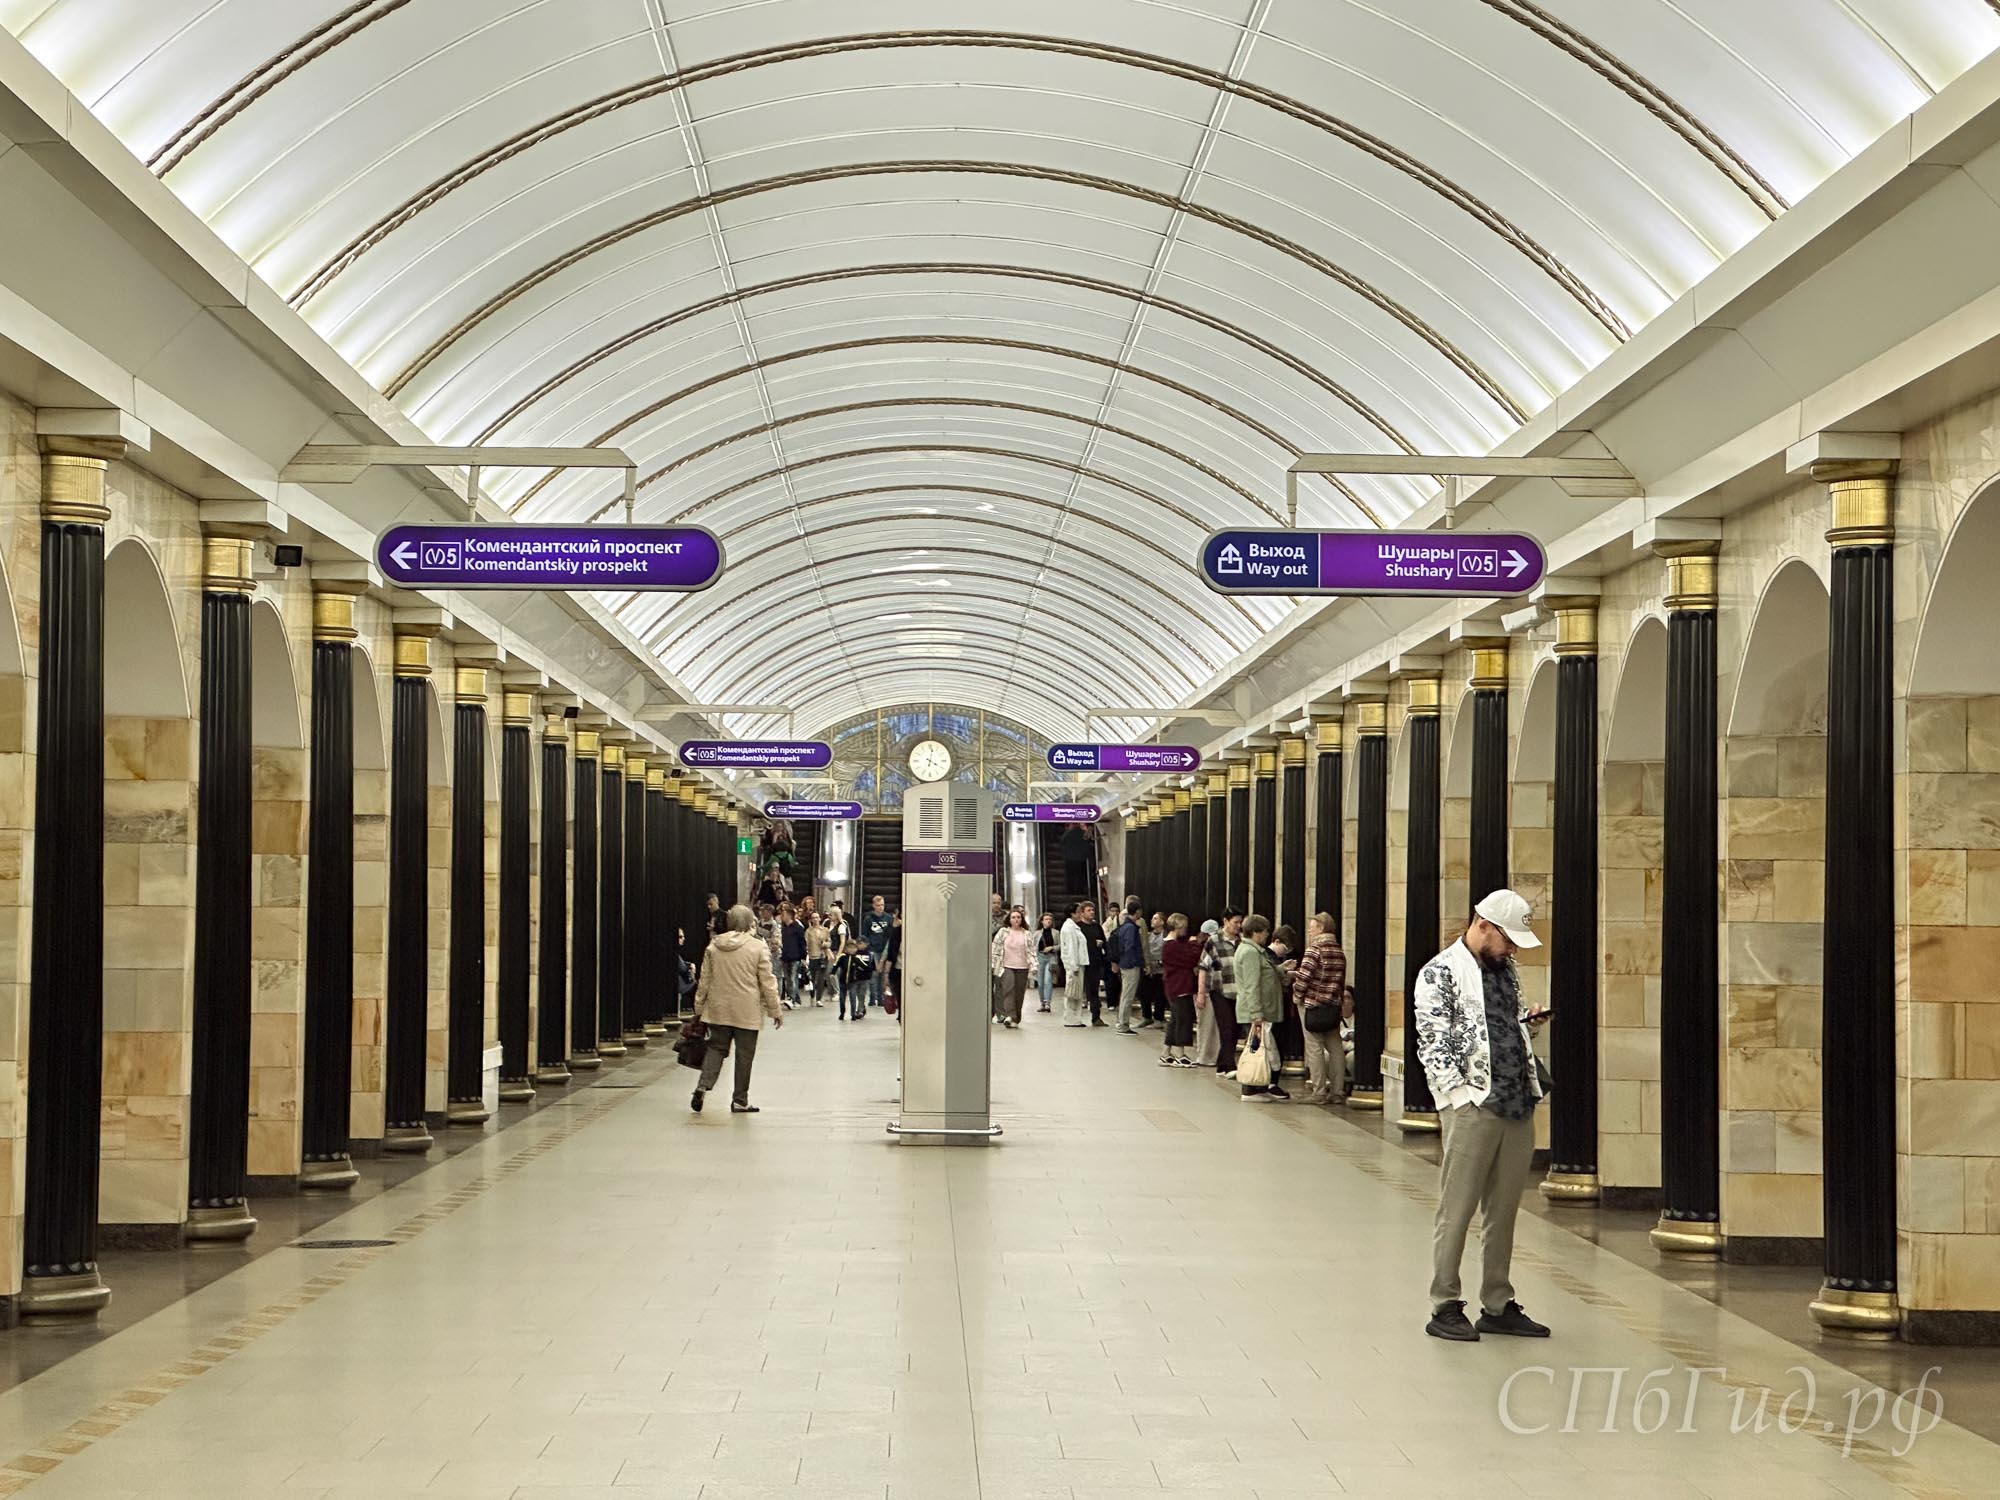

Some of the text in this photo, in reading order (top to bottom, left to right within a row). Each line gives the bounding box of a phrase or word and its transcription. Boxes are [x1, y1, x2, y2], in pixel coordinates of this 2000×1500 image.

[465, 539, 600, 554] Комендантский
[605, 543, 682, 557] проспект
[1250, 544, 1305, 559] Выход
[1379, 545, 1454, 561] Шушары
[465, 558, 647, 574] Komendantskiy prospekt
[1247, 563, 1308, 577] Way out
[1386, 563, 1453, 580] Shushary
[718, 746, 778, 754] Комендантский
[780, 748, 815, 756] проспект
[1126, 751, 1160, 759] Шушары
[717, 755, 800, 763] Komendantskiy prospekt
[1129, 759, 1160, 767] Shushary
